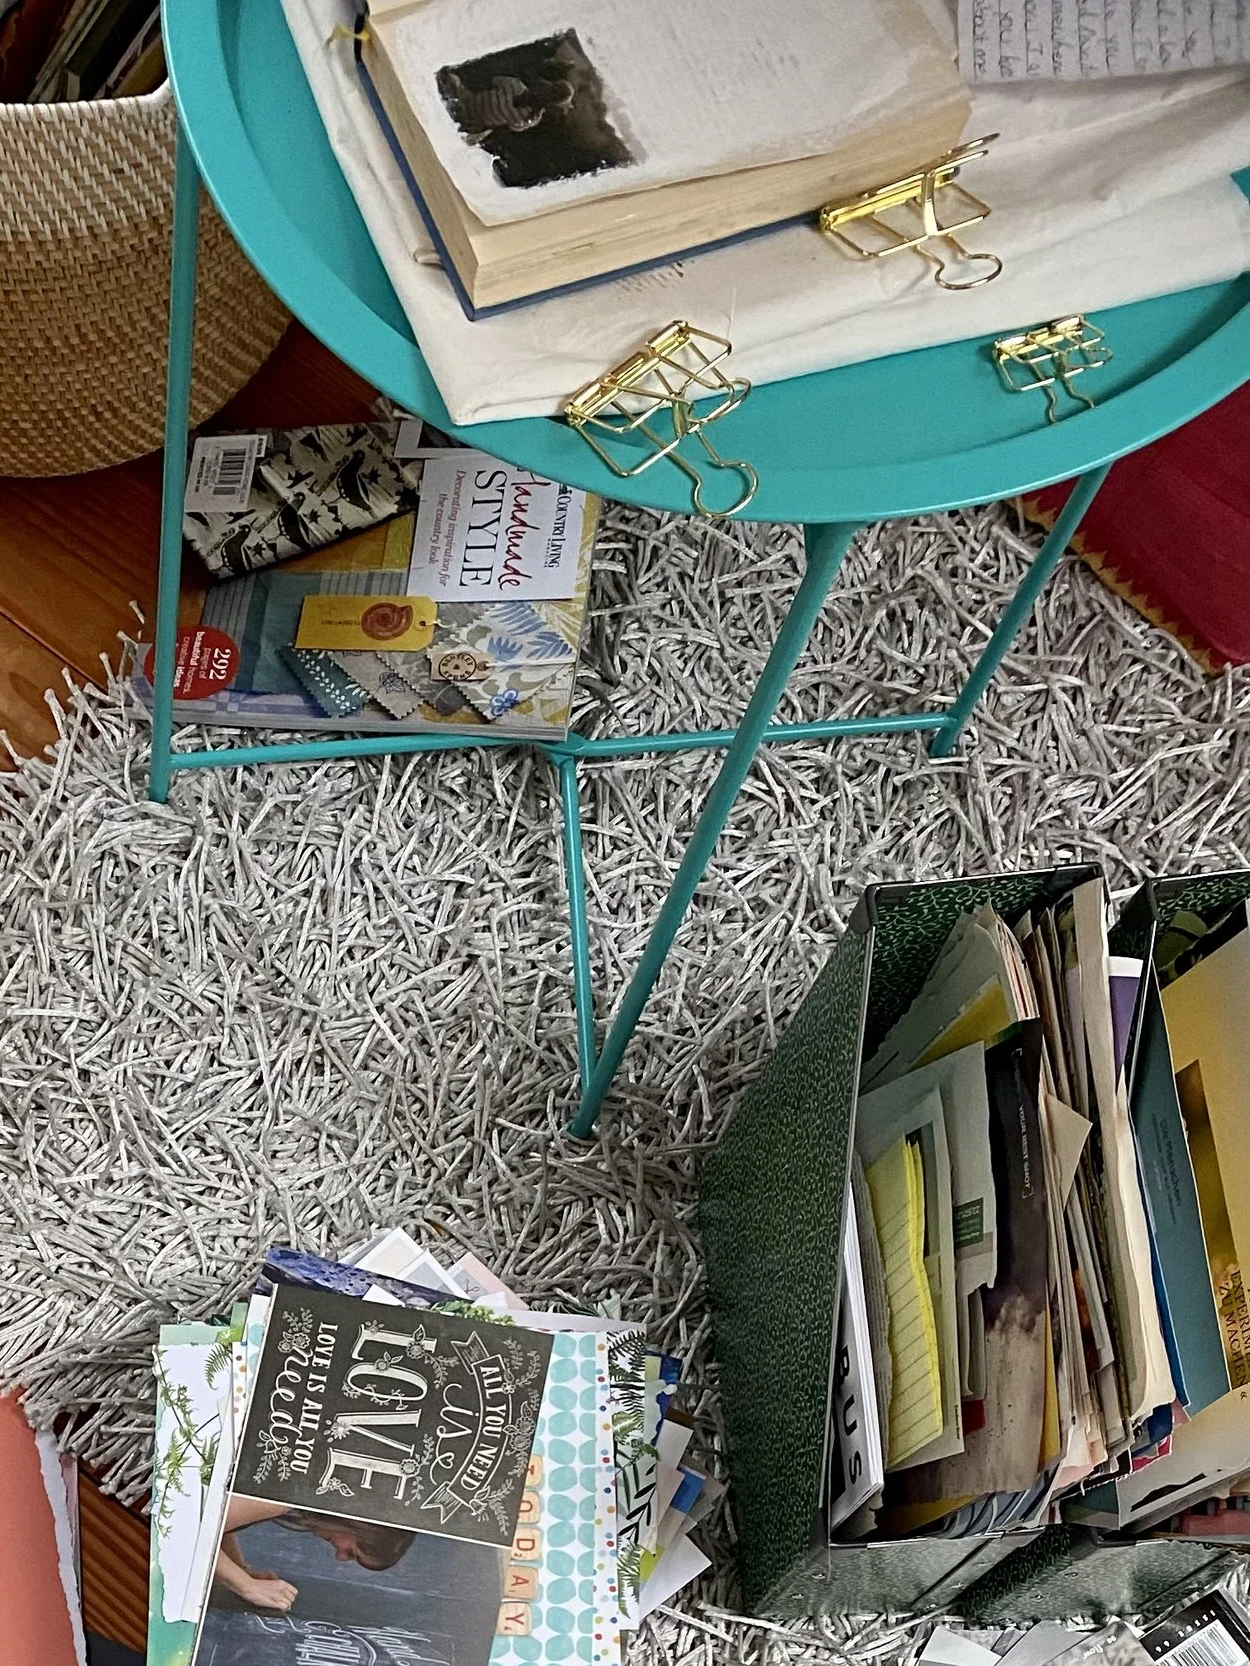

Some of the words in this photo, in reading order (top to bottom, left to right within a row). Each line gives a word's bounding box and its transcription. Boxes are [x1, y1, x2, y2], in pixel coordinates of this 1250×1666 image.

[437, 493, 448, 508] the
[448, 470, 467, 521] Decorating
[430, 509, 444, 544] country
[459, 470, 507, 587] STYLE
[498, 467, 551, 591] Handmade
[552, 496, 571, 536] COUNTRY
[428, 545, 440, 565] look
[441, 523, 458, 571] inspiration
[548, 538, 566, 568] LIVING
[438, 572, 449, 587] for
[190, 631, 206, 666] beautiful
[210, 648, 231, 680] 292
[173, 666, 185, 688] ideas
[1017, 1105, 1028, 1133] YOUR
[1021, 1135, 1030, 1160] BEST
[1022, 1161, 1033, 1190] SHOT
[311, 1322, 338, 1370] LOVE
[268, 1346, 313, 1450] need
[306, 1371, 328, 1394] IS
[479, 1365, 505, 1400] ALL
[298, 1397, 323, 1433] ALL
[318, 1323, 438, 1500] LOVE
[480, 1404, 507, 1439] YOU
[835, 1344, 863, 1485] BUS
[290, 1437, 315, 1475] YOU
[459, 1441, 498, 1492] NEED
